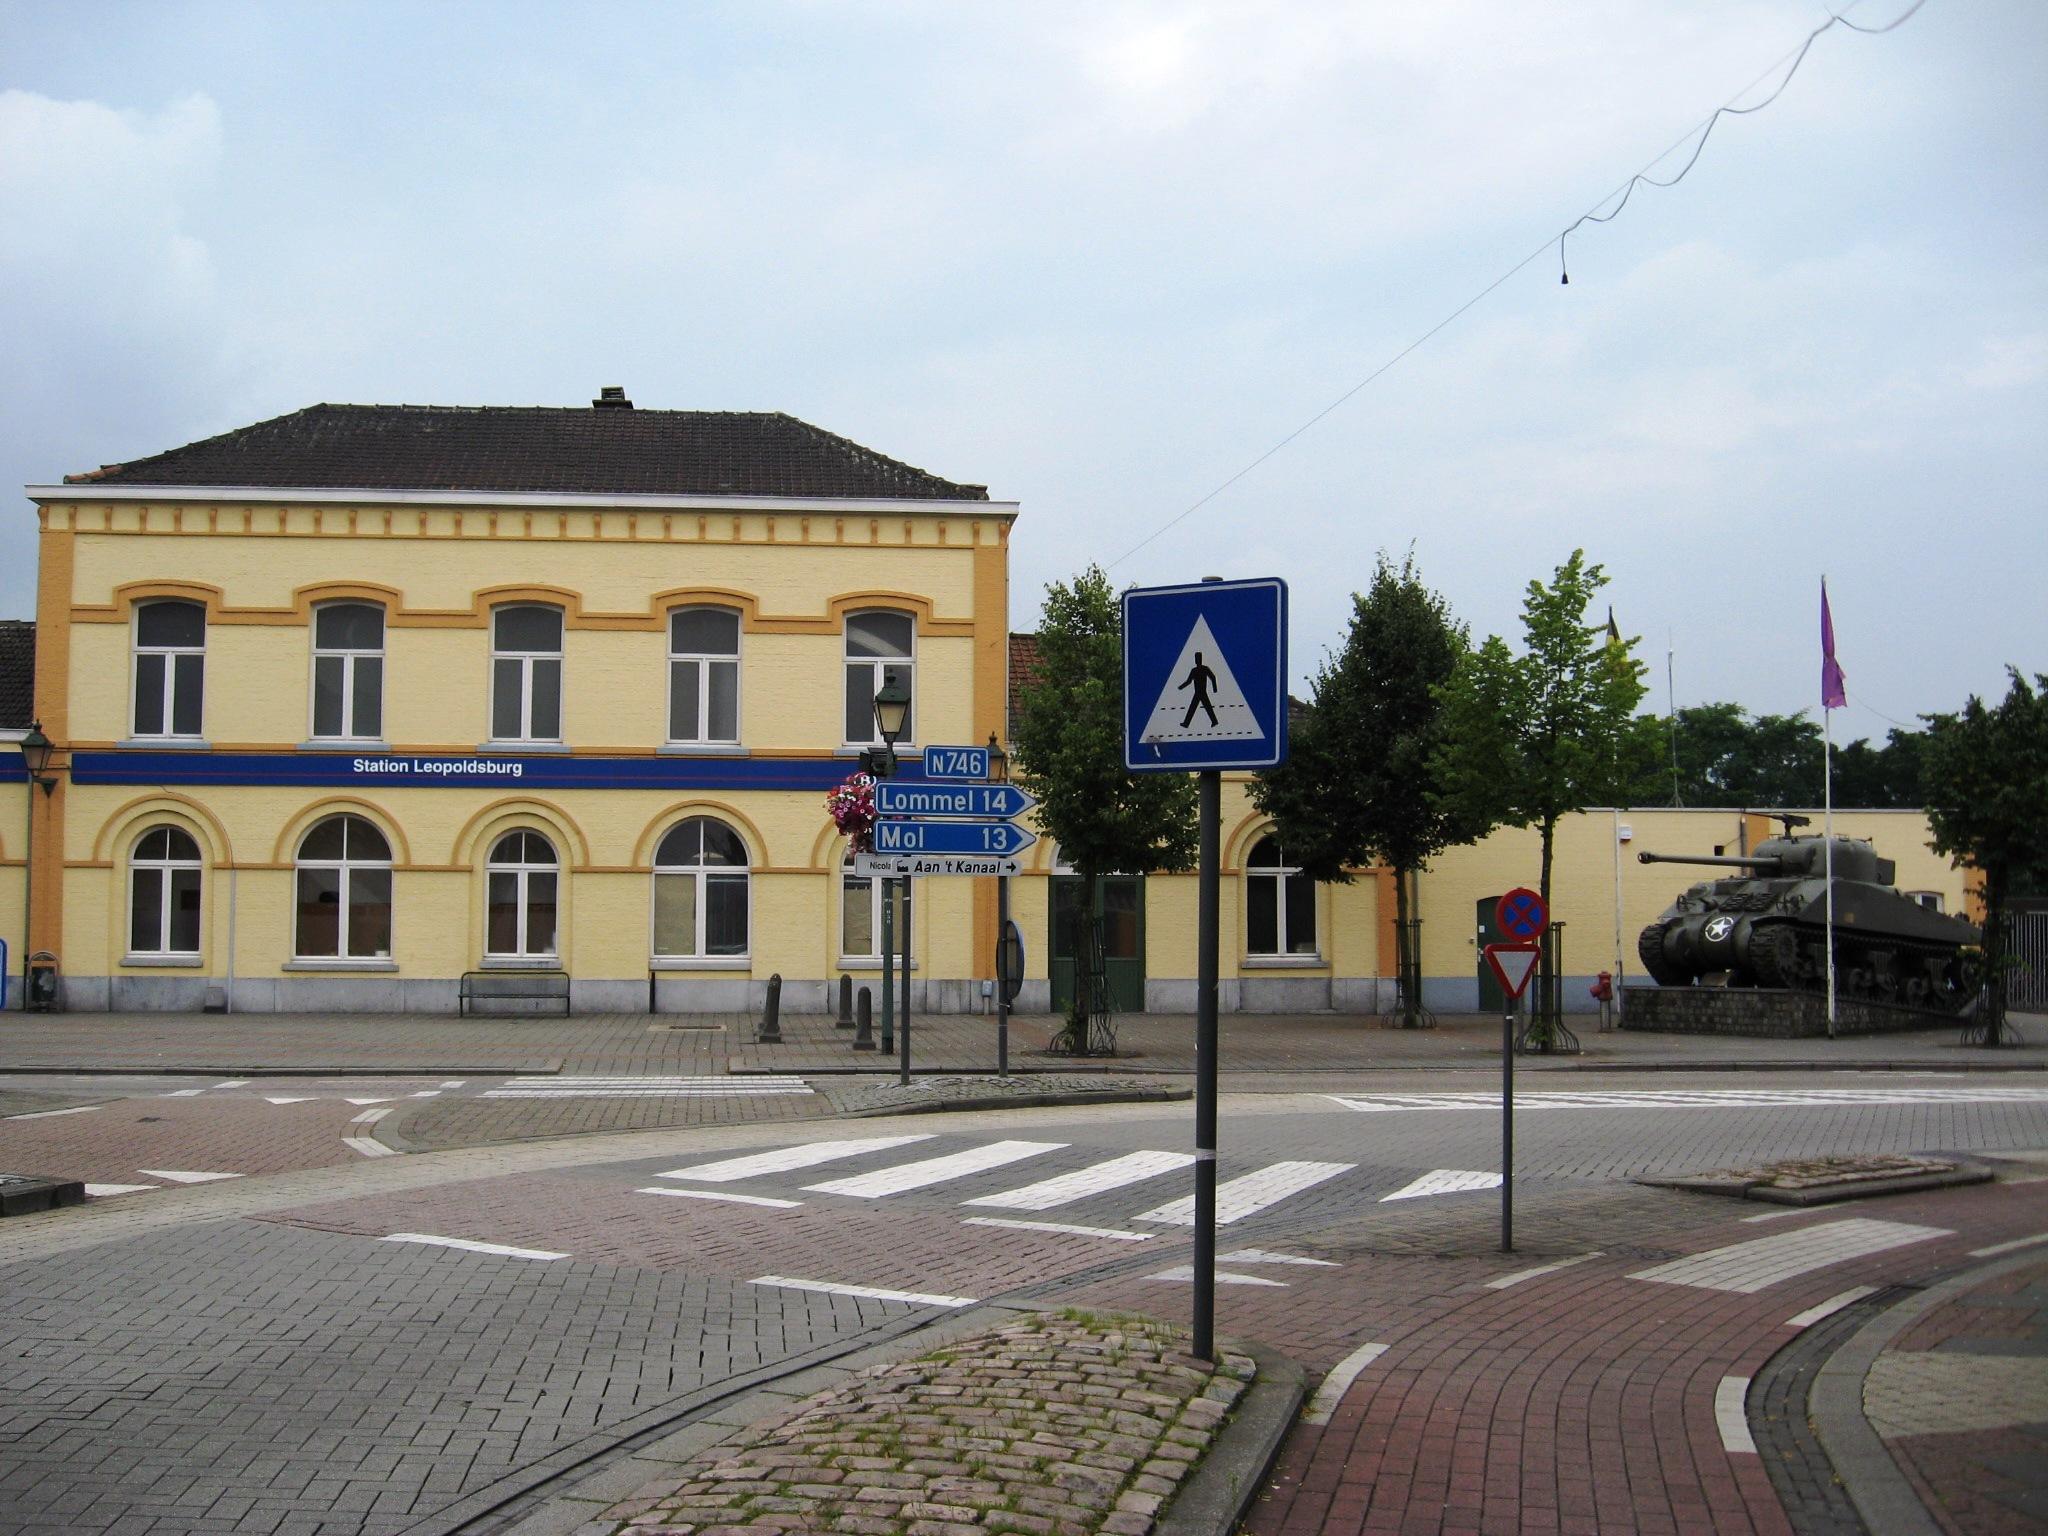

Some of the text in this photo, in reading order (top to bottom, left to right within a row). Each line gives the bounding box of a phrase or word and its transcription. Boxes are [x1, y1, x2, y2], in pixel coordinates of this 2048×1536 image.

[353, 758, 523, 777] Station Leopoldsburg
[932, 752, 982, 775] N746
[881, 787, 1007, 812] Lommel 14
[881, 825, 1008, 850] Mol 13
[914, 860, 1001, 874] Aan 't Kanaal
